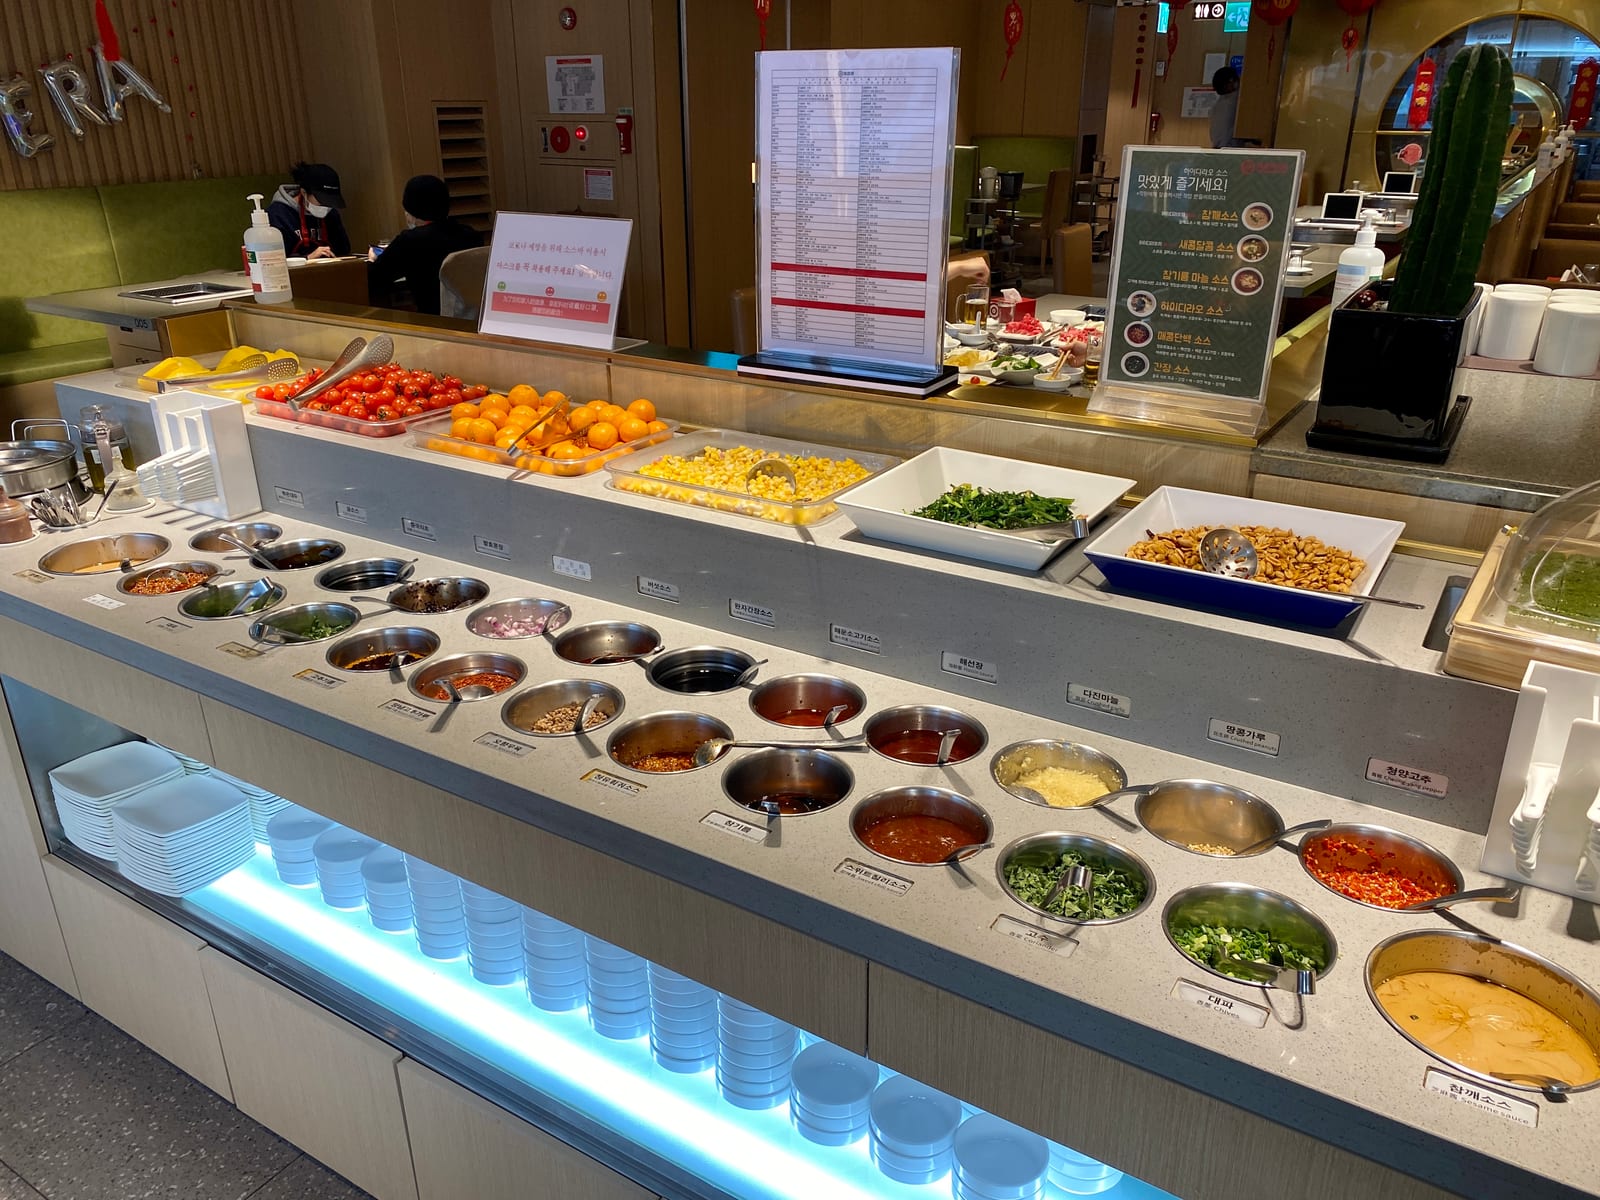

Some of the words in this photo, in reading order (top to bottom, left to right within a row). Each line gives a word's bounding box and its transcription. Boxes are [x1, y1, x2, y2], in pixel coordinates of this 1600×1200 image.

[1184, 167, 1214, 176] 하이디라오
[1216, 169, 1228, 177] 소스
[1138, 174, 1173, 190] 맛있게
[1176, 176, 1228, 192] 즐기세요!
[1201, 209, 1238, 222] 참깨소스
[1179, 239, 1214, 252] 새콤달콤
[1216, 242, 1234, 252] 소스
[1162, 269, 1190, 281] 참기름
[1191, 272, 1209, 284] 마늘
[1211, 274, 1229, 285] 소스
[1160, 301, 1204, 314] 하이디라오
[1205, 305, 1225, 316] 소스
[134, 318, 149, 329] 005
[1193, 335, 1211, 345] 소스
[1153, 362, 1171, 373] 간장
[1173, 365, 1190, 375] 소스
[647, 580, 672, 593] 버섯소스
[833, 626, 880, 644] 매운소고기소스
[959, 657, 983, 670] 해선장
[1083, 688, 1119, 705] 다진마늘
[1226, 725, 1266, 742] 땅콩가루
[1386, 766, 1432, 784] 청양고추
[724, 819, 752, 834] 참기름
[844, 863, 908, 891] 스위트칠리소스
[1025, 929, 1049, 942] 고수
[1208, 994, 1234, 1010] 대파
[1449, 1083, 1512, 1112] 참깨소스
[1460, 1096, 1498, 1115] Sesame
[1500, 1110, 1530, 1126] sauce
